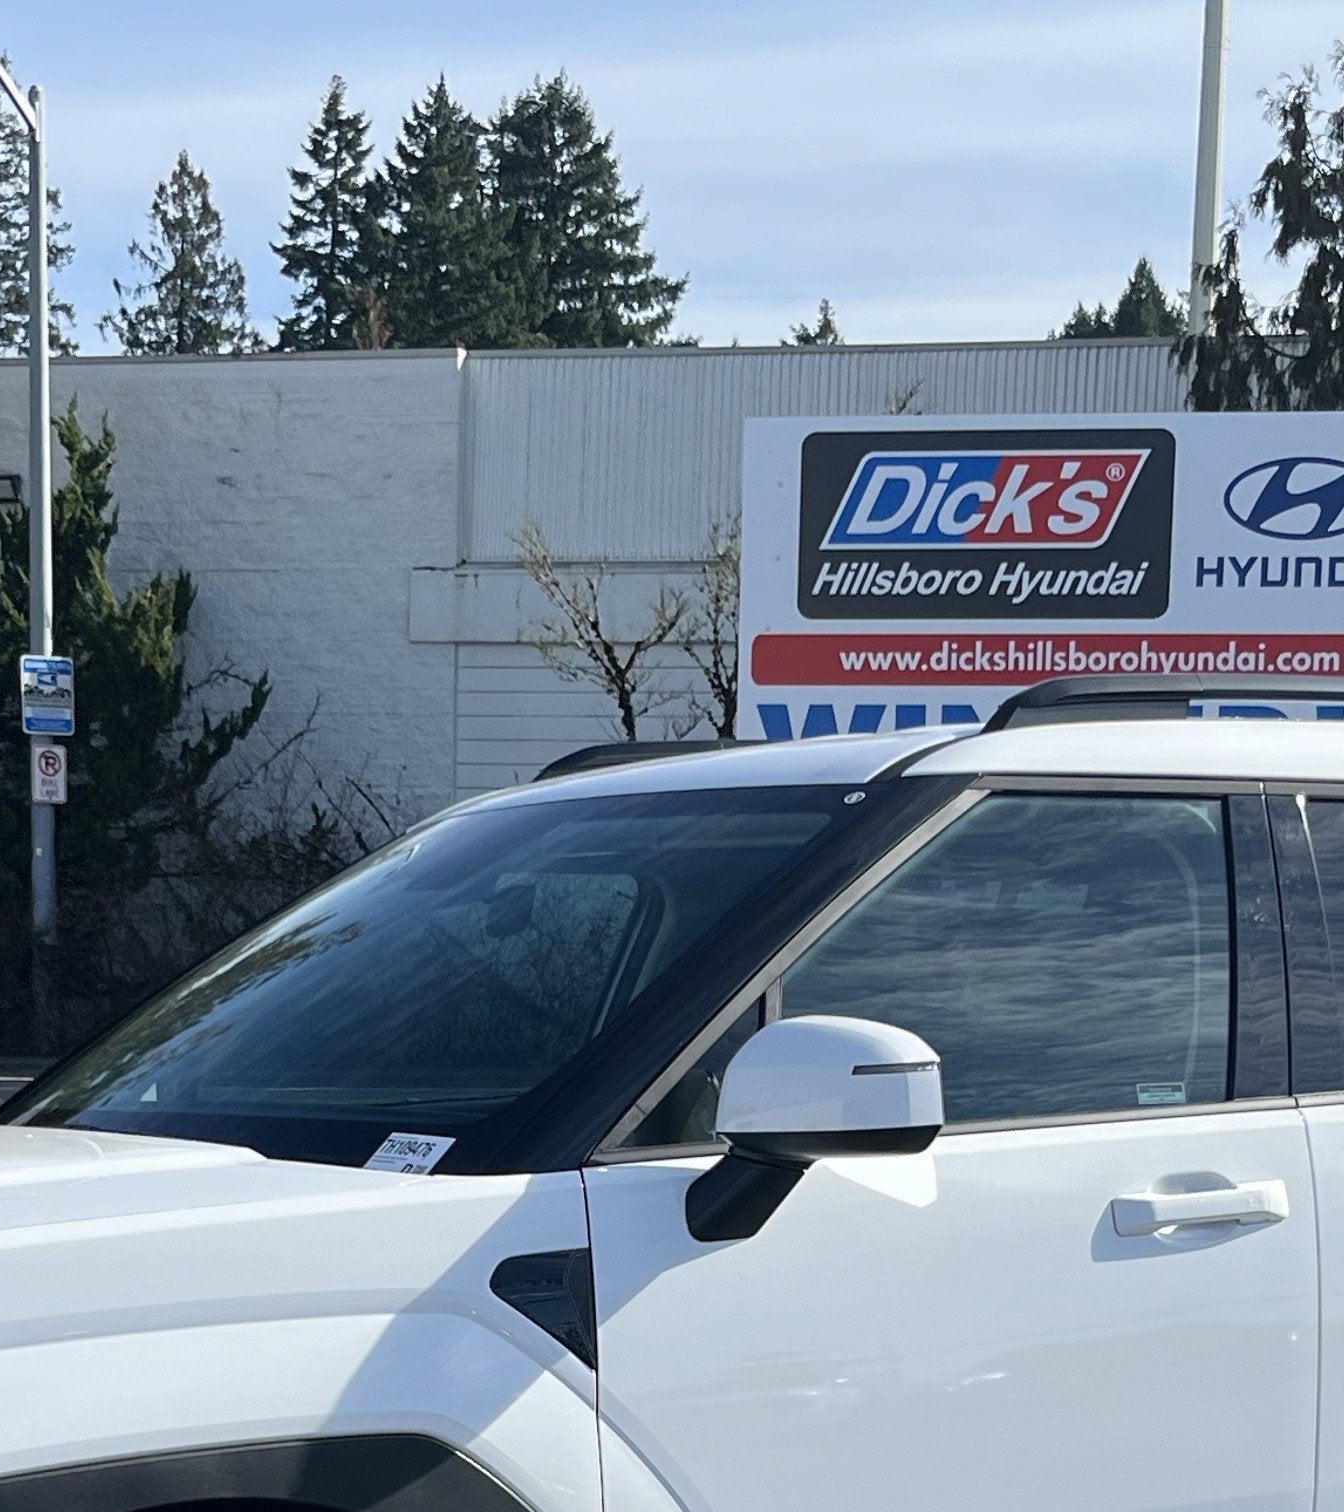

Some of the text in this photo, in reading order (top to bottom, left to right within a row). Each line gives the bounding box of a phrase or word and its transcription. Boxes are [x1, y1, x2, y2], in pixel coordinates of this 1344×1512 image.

[811, 560, 1149, 604] Hillsboro Hyundai
[838, 640, 1340, 677] www.dickshillsborohyundai.com
